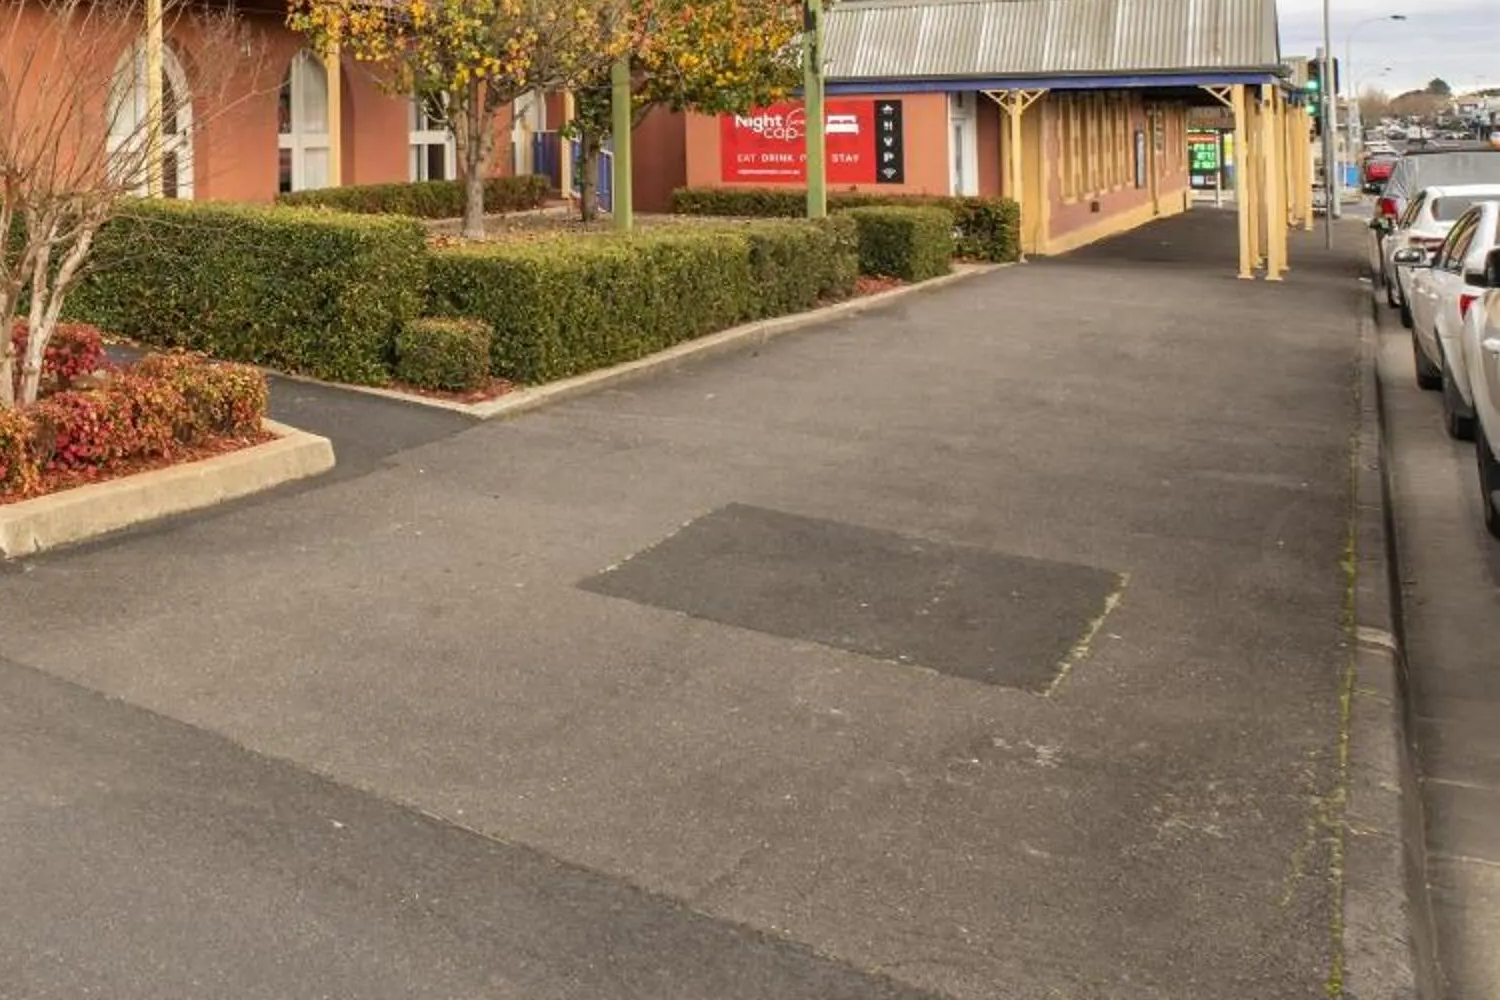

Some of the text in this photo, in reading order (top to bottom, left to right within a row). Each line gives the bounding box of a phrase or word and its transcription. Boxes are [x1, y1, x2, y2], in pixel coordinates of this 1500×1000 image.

[735, 113, 783, 134] Night
[763, 127, 798, 141] cap
[737, 153, 756, 163] EAT
[761, 153, 793, 163] DRINK
[831, 153, 859, 164] STAY
